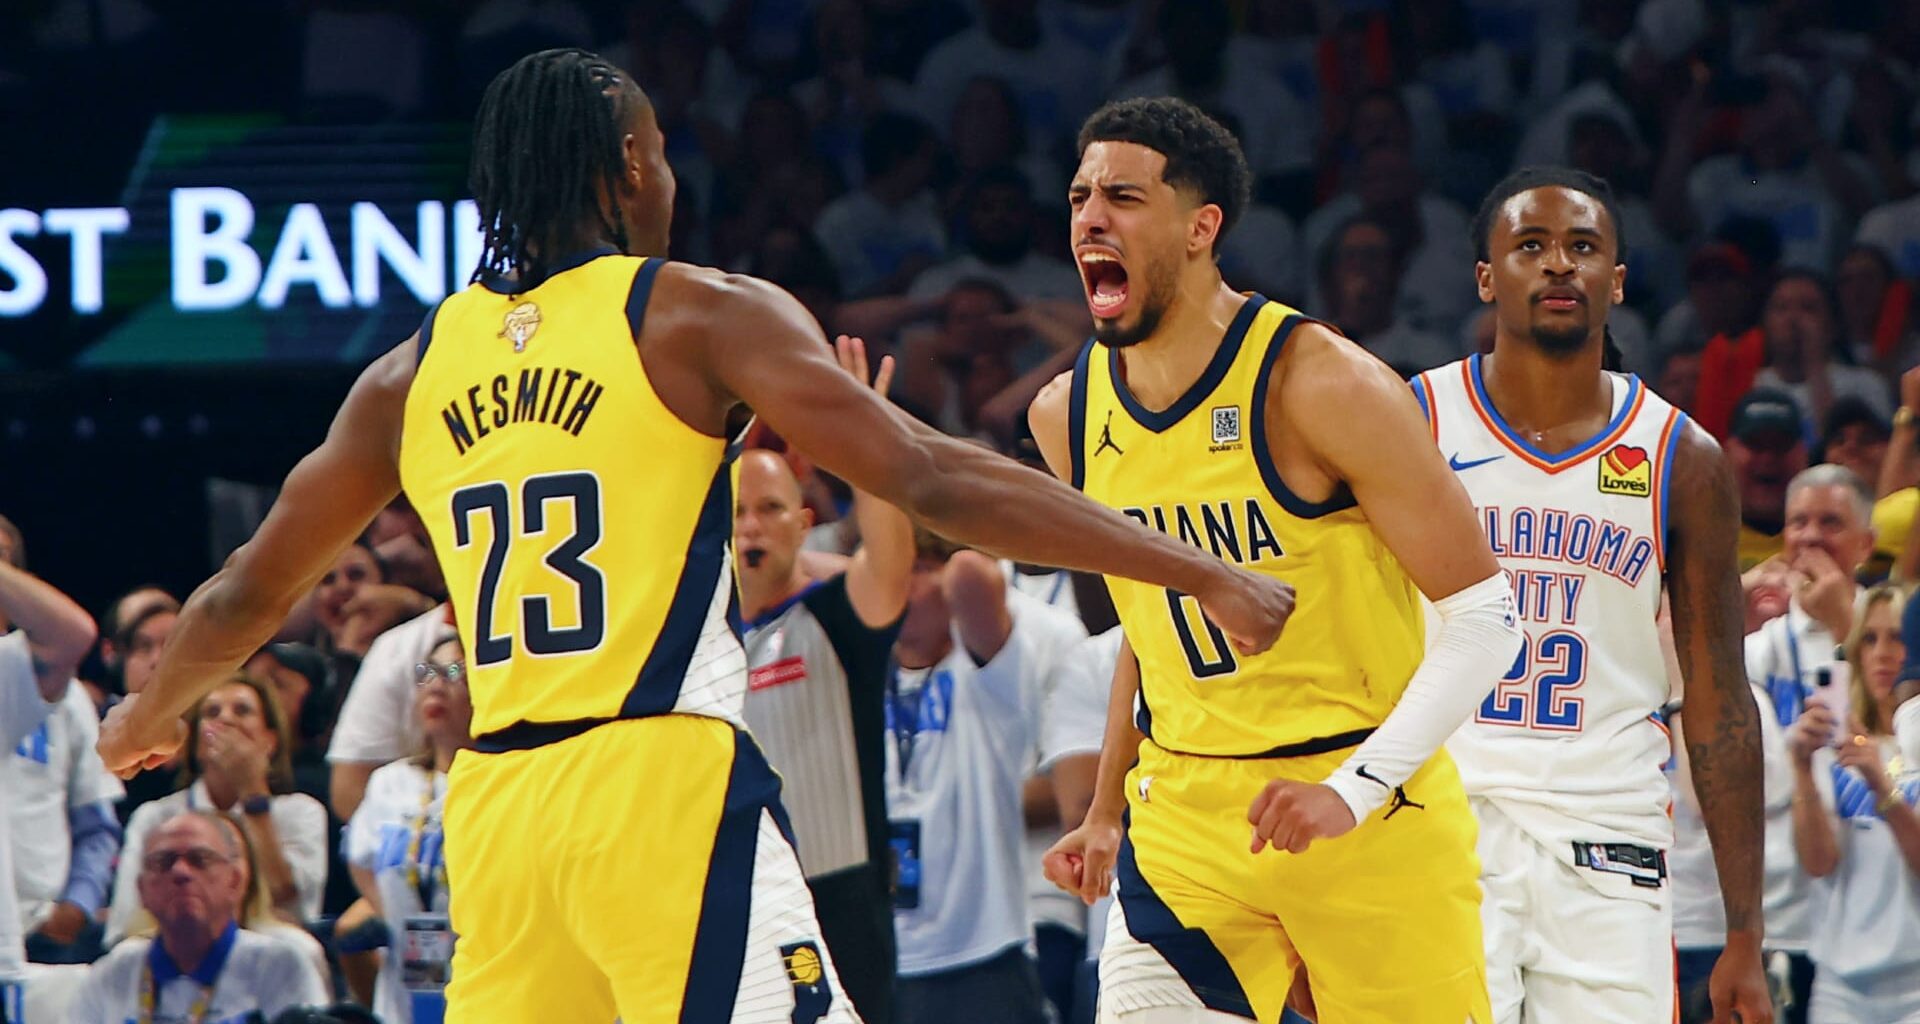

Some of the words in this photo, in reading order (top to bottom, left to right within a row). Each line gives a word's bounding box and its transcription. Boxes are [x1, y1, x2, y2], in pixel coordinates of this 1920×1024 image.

[0, 207, 130, 317] ST
[441, 367, 604, 456] NESMITH
[451, 469, 605, 668] 23
[1475, 506, 1655, 588] LAHOMA
[1164, 586, 1238, 680] 0
[1502, 568, 1586, 625] ITY
[1474, 628, 1589, 732] 22
